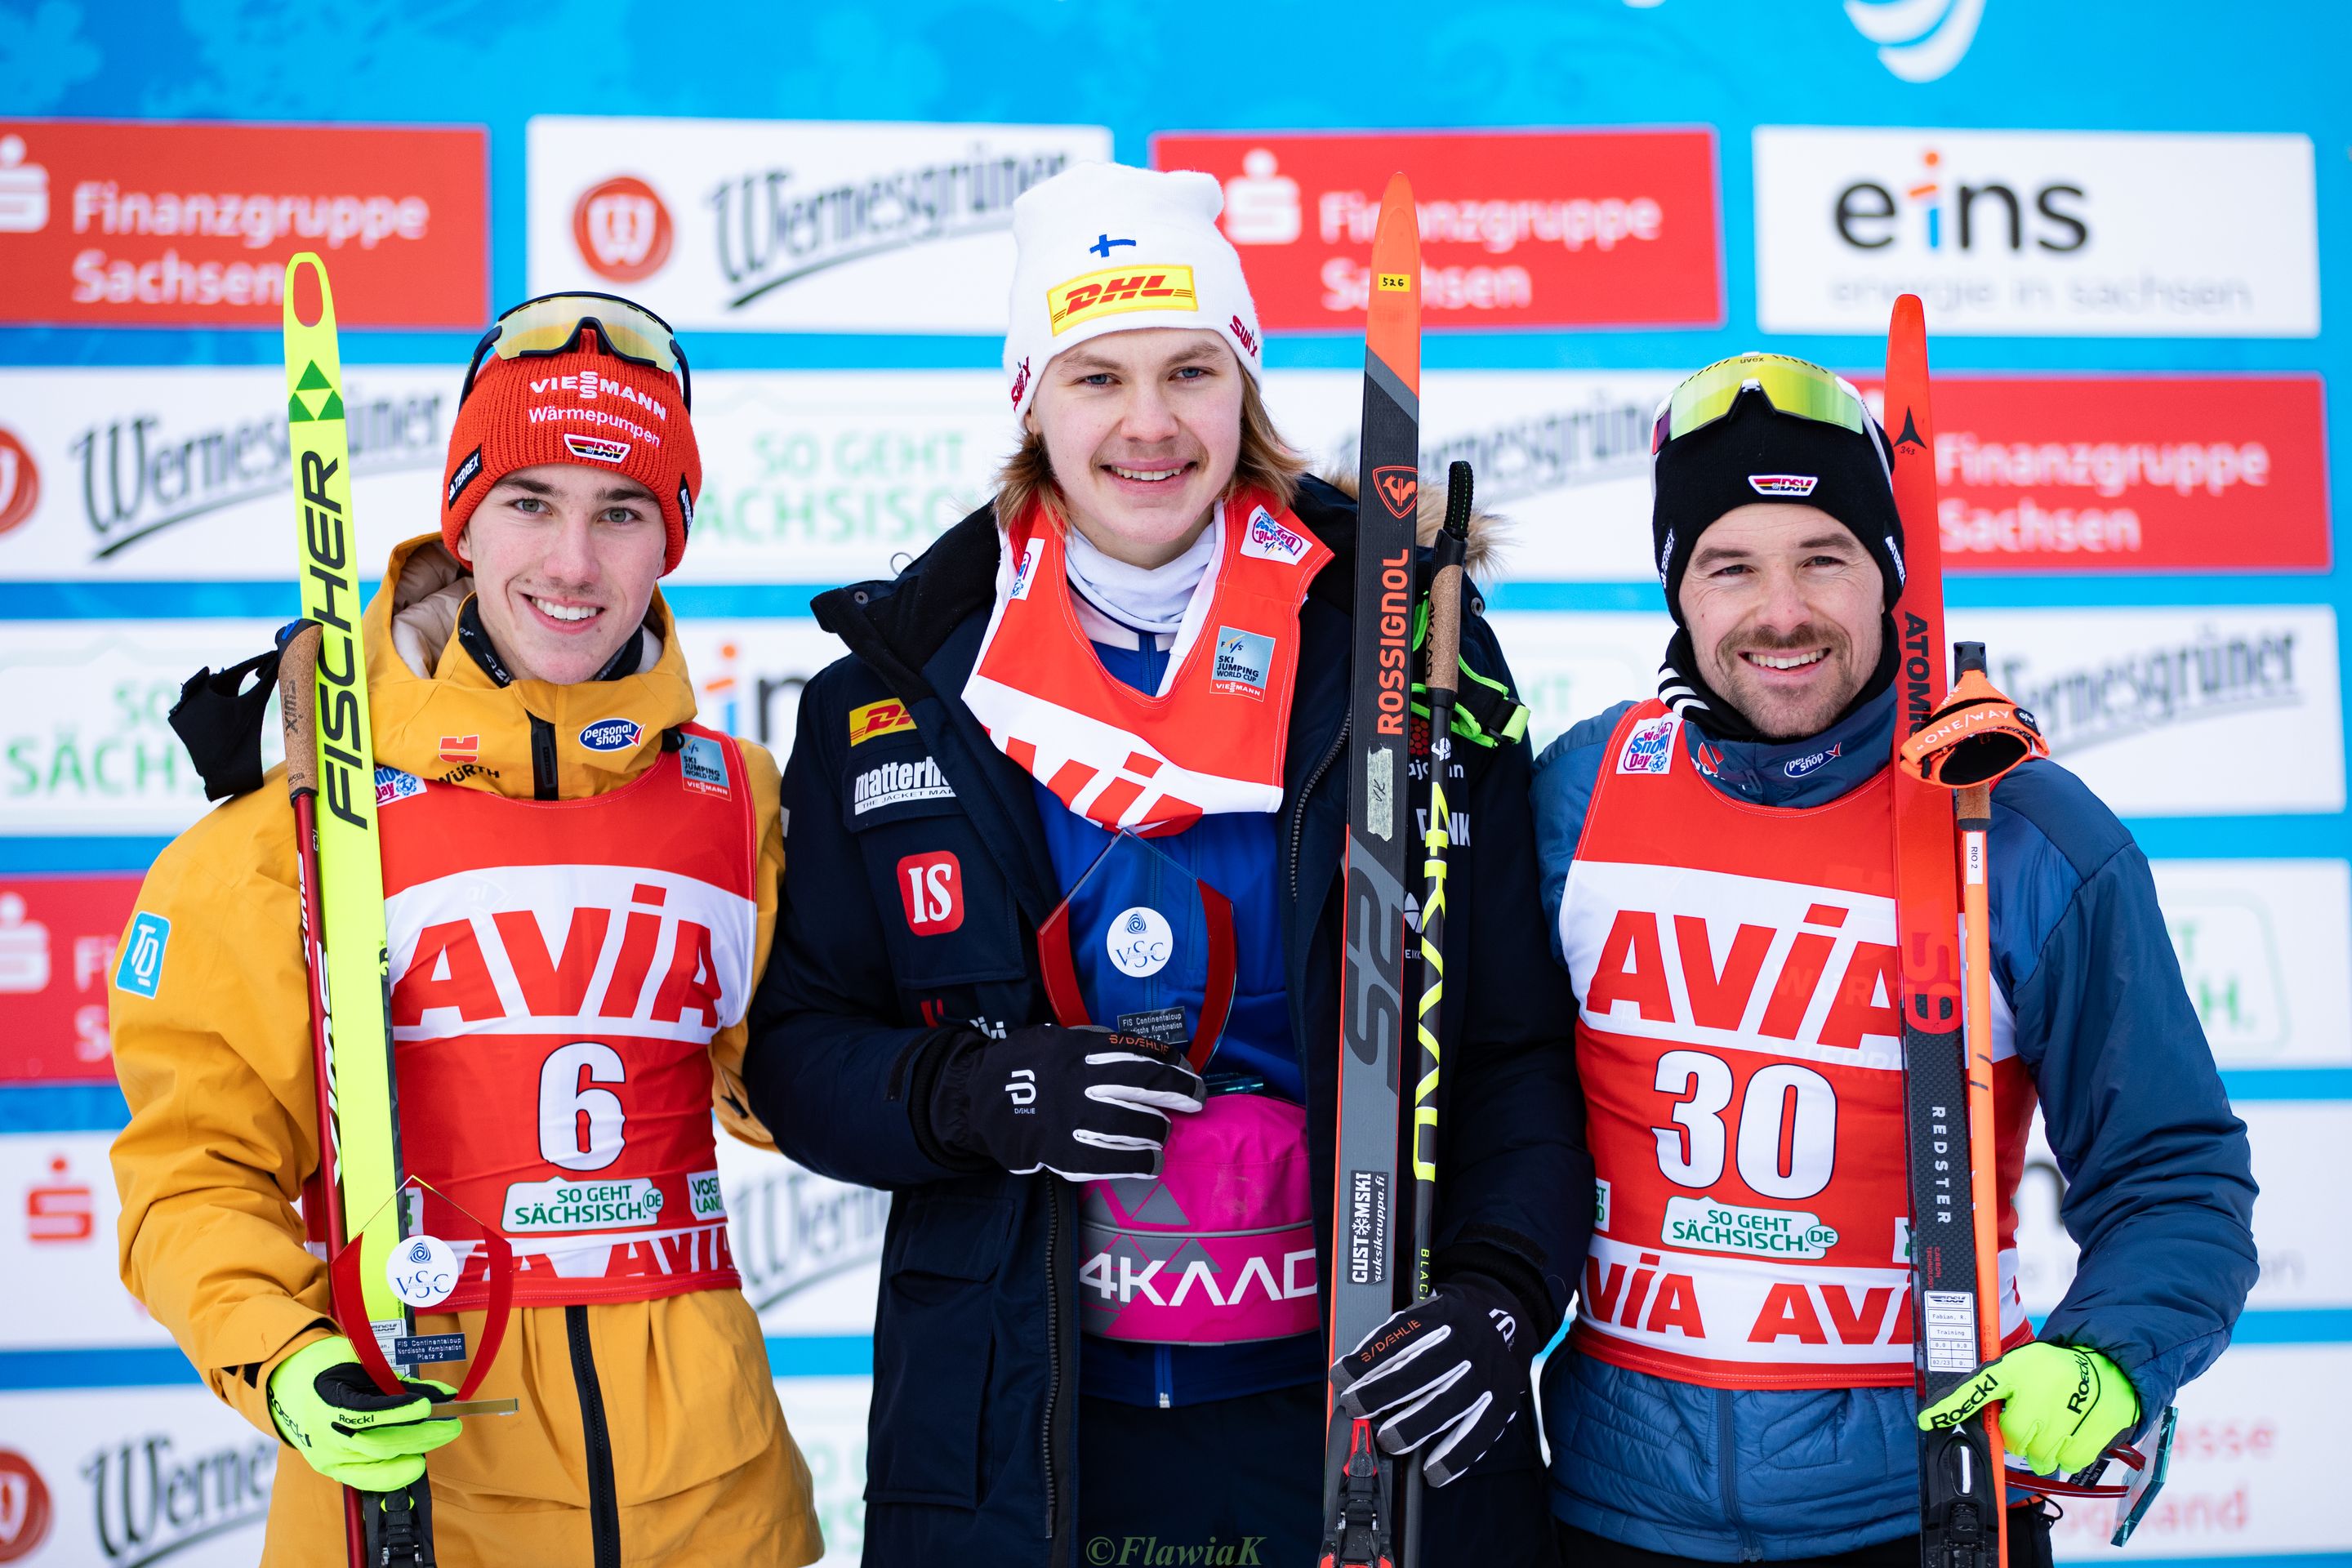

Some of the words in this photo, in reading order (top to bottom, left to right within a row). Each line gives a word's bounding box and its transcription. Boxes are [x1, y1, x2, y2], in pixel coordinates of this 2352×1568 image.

[1833, 149, 2091, 252] eins
[74, 183, 430, 248] Finanzgruppe
[74, 250, 284, 305] Sachsen
[1383, 278, 1405, 287] 526
[1065, 275, 1174, 315] DHL
[530, 371, 667, 421] VIESSMANN
[528, 405, 661, 448] Wärmepumpen
[596, 442, 626, 459] DSV
[454, 452, 480, 491] TERREX
[1932, 433, 2270, 497] Finanzgruppe
[1939, 497, 2143, 553] Sachsen
[301, 451, 368, 831] FISCHER
[1377, 549, 1409, 735] ROSSIGNOL
[1217, 663, 1259, 678] JUMPING
[1218, 655, 1234, 664] SKI
[1215, 682, 1261, 697] VIESSMANN
[1216, 670, 1242, 679] WORLD
[1243, 675, 1257, 683] CUP
[585, 723, 632, 742] personal
[595, 733, 622, 746] shop
[1630, 734, 1668, 755] Snow
[684, 755, 697, 765] SKI
[684, 762, 720, 777] JUMPING
[1629, 753, 1652, 768] Day
[684, 770, 706, 781] WORLD
[707, 774, 720, 782] CUP
[687, 781, 728, 795] VIESSMANN
[862, 800, 879, 809] THE
[882, 791, 924, 804] JACKET
[907, 863, 952, 924] IS
[1116, 941, 1166, 969] VSC
[1123, 1018, 1134, 1027] FIS
[1136, 1013, 1183, 1026] Continentalcup
[1152, 1022, 1183, 1032] Kombination
[537, 1041, 626, 1171] 6
[1652, 1049, 1837, 1200] 30
[1931, 1105, 1952, 1225] REDSTER
[556, 1189, 582, 1204] SO
[587, 1184, 633, 1202] GEHT
[514, 1201, 648, 1225] SÄCHSISCH.
[645, 1193, 662, 1208] DE
[1707, 1209, 1734, 1224] SO
[1737, 1214, 1793, 1233] GEHT
[1372, 1174, 1386, 1284] suksikauppa.fi
[1672, 1218, 1811, 1253] SÄCHSISCH.
[1810, 1230, 1835, 1245] DE
[1934, 1246, 1942, 1279] CARBON
[395, 1270, 450, 1298] VSC
[1936, 1329, 1966, 1337] Training
[428, 1344, 462, 1353] Kombination
